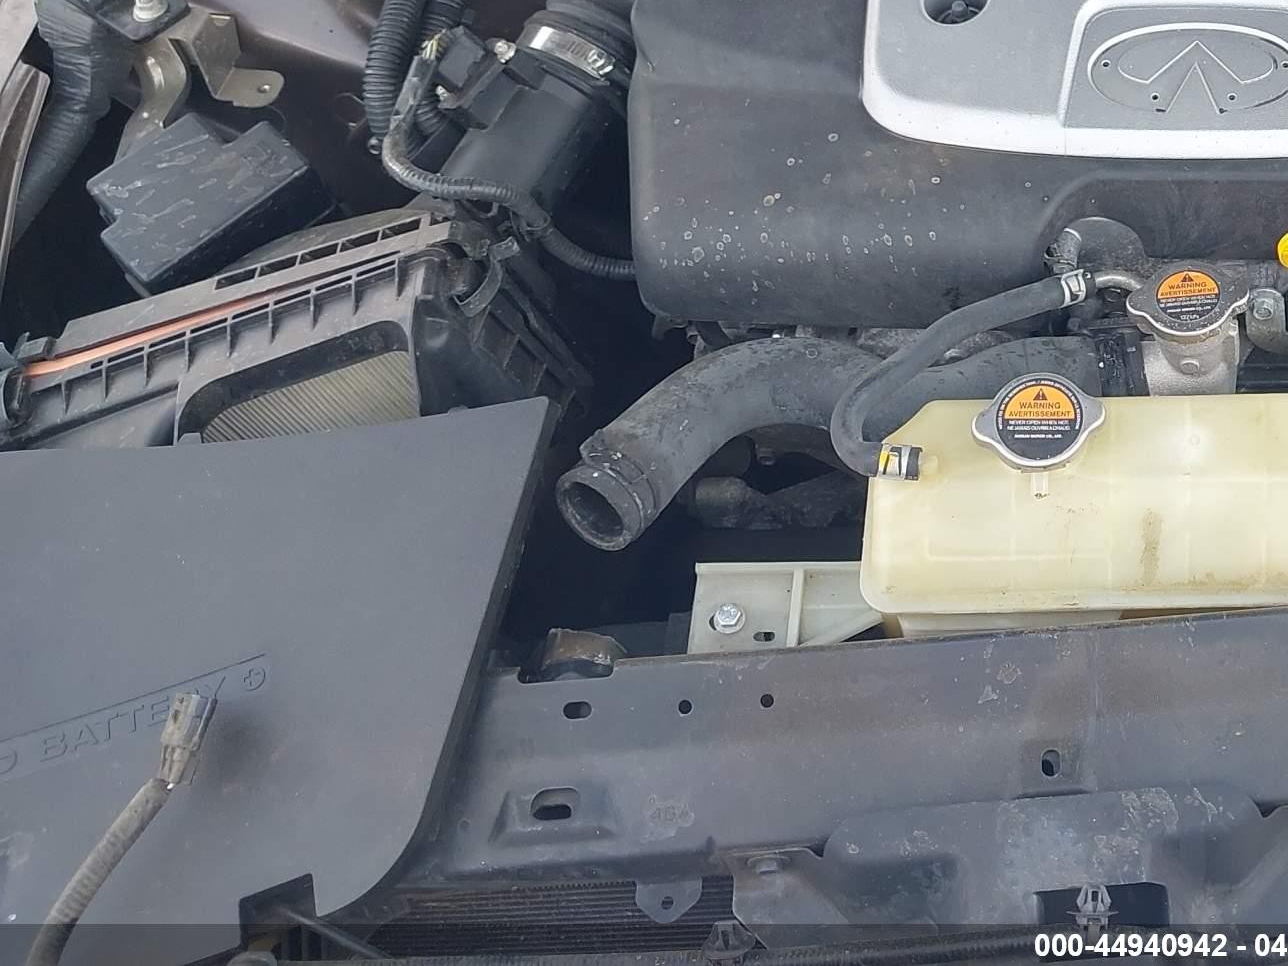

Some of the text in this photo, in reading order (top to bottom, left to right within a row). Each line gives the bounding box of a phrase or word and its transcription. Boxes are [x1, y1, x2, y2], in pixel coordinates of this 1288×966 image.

[1168, 282, 1207, 290] WARNING
[1160, 287, 1216, 296] AVERTISSEMENT
[1019, 401, 1061, 409] WARNING
[1008, 410, 1072, 418] AVERTISSEMENT
[40, 676, 226, 762] BATTEY
